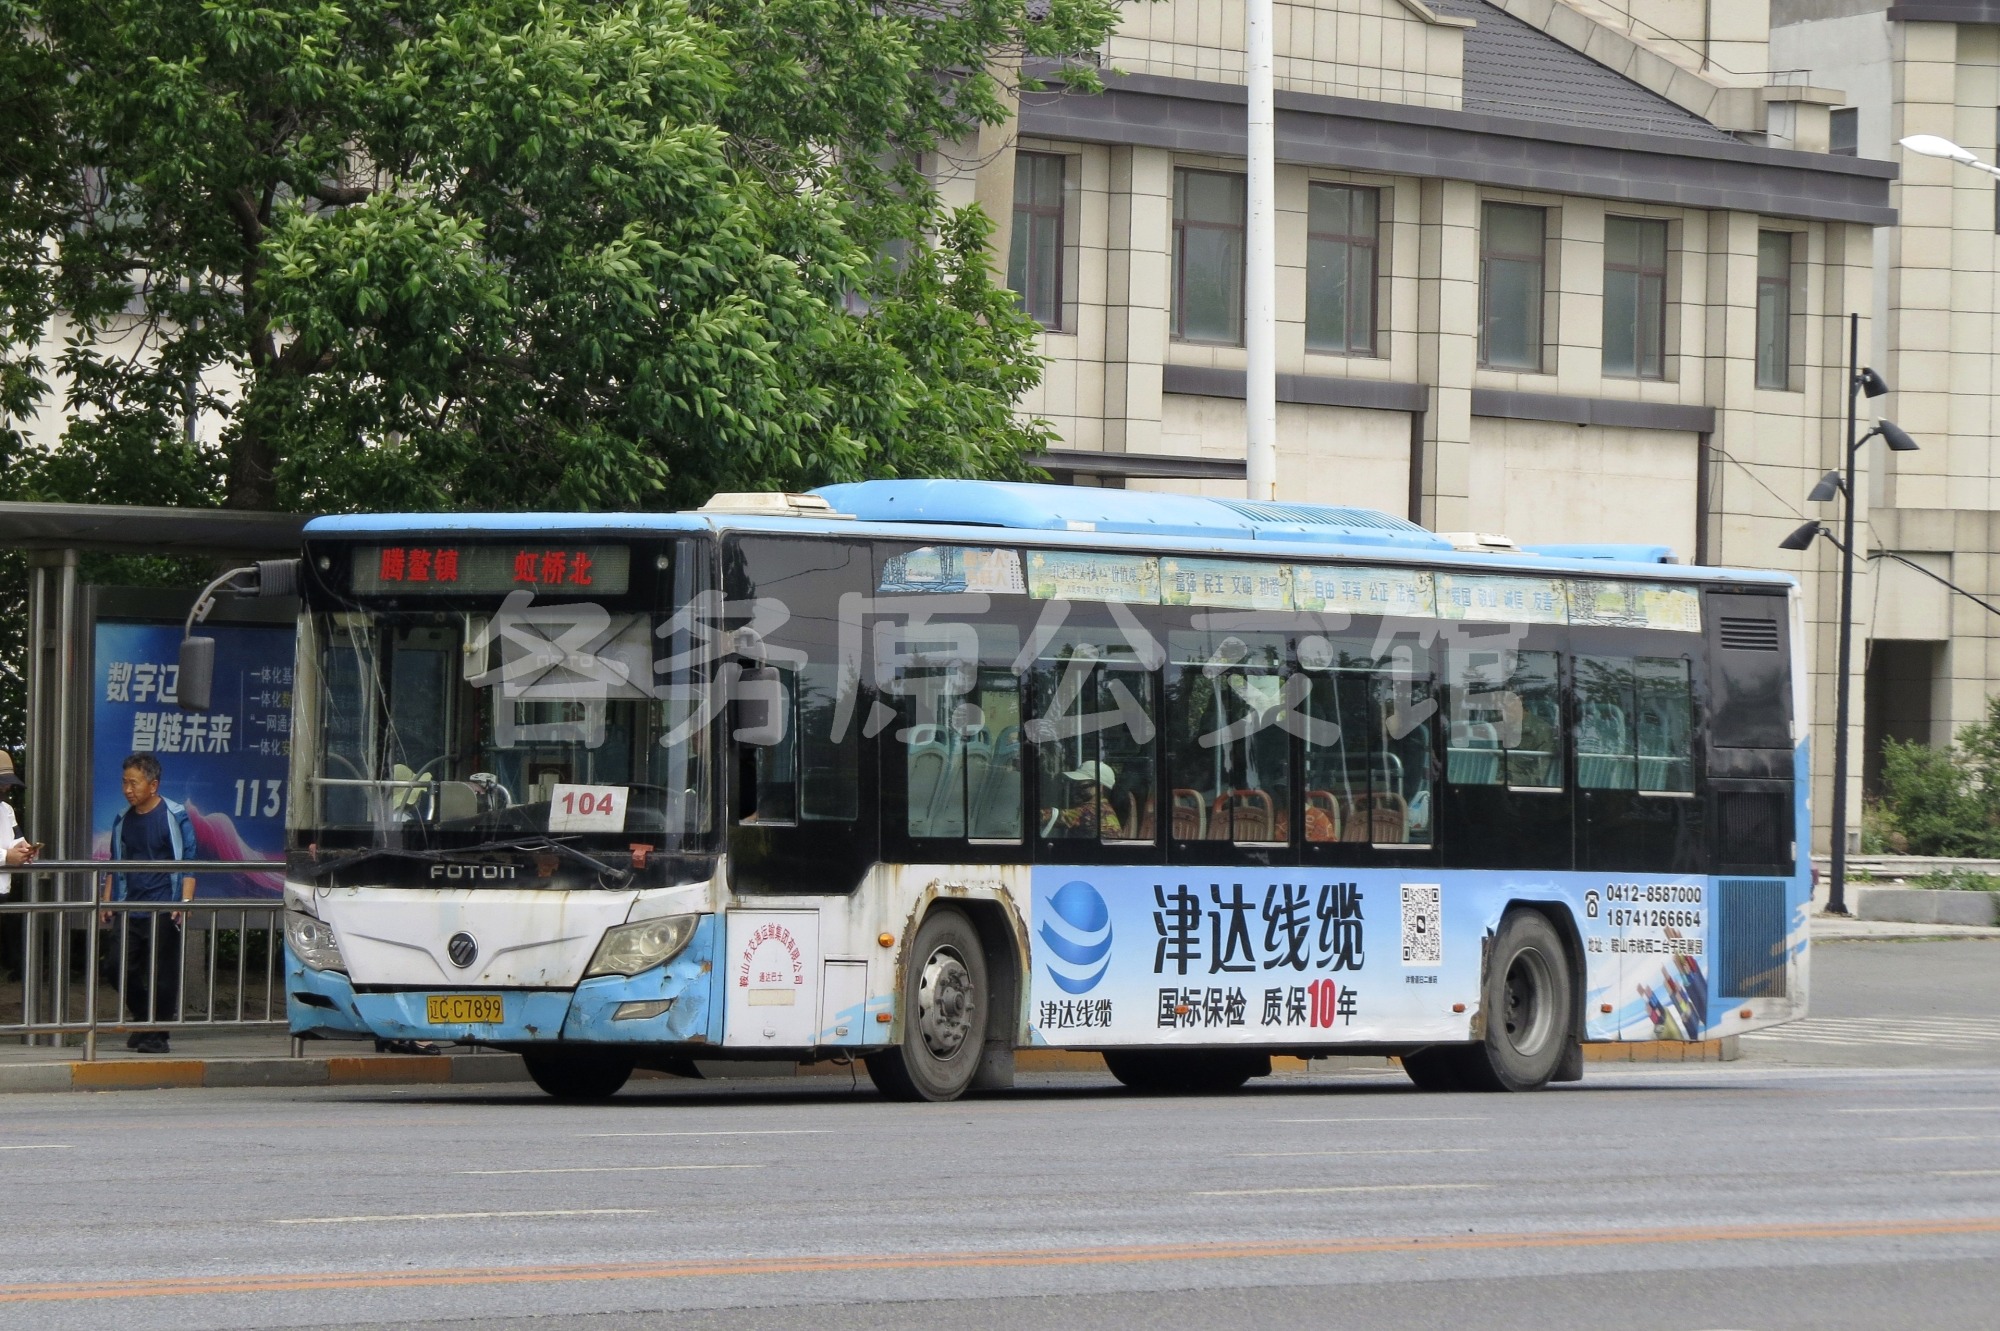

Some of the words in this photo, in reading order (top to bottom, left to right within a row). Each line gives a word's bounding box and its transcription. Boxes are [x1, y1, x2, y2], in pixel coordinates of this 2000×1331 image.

[380, 547, 459, 581] 腾鳌镇
[513, 550, 593, 584] 虹桥北
[1176, 572, 1197, 593] 富强
[1204, 573, 1225, 594] 民主
[1231, 575, 1252, 596] 文明
[1260, 576, 1280, 597] 和谐
[1315, 580, 1335, 599] 自由
[1342, 580, 1362, 600] 平等
[1369, 581, 1388, 601] 公正
[1451, 587, 1472, 607] 爱国
[1533, 591, 1553, 611] 友善
[131, 712, 233, 753] 智链未来
[562, 792, 613, 816] 104
[430, 865, 515, 879] FOTON
[1606, 884, 1702, 903] 0412-8587000
[1153, 882, 1365, 975] 津达线缆
[1607, 909, 1701, 927] 18741266664
[1039, 998, 1113, 1028] 津达线缆
[1156, 985, 1247, 1029] 国标保检
[1260, 978, 1358, 1029] 质保10年
